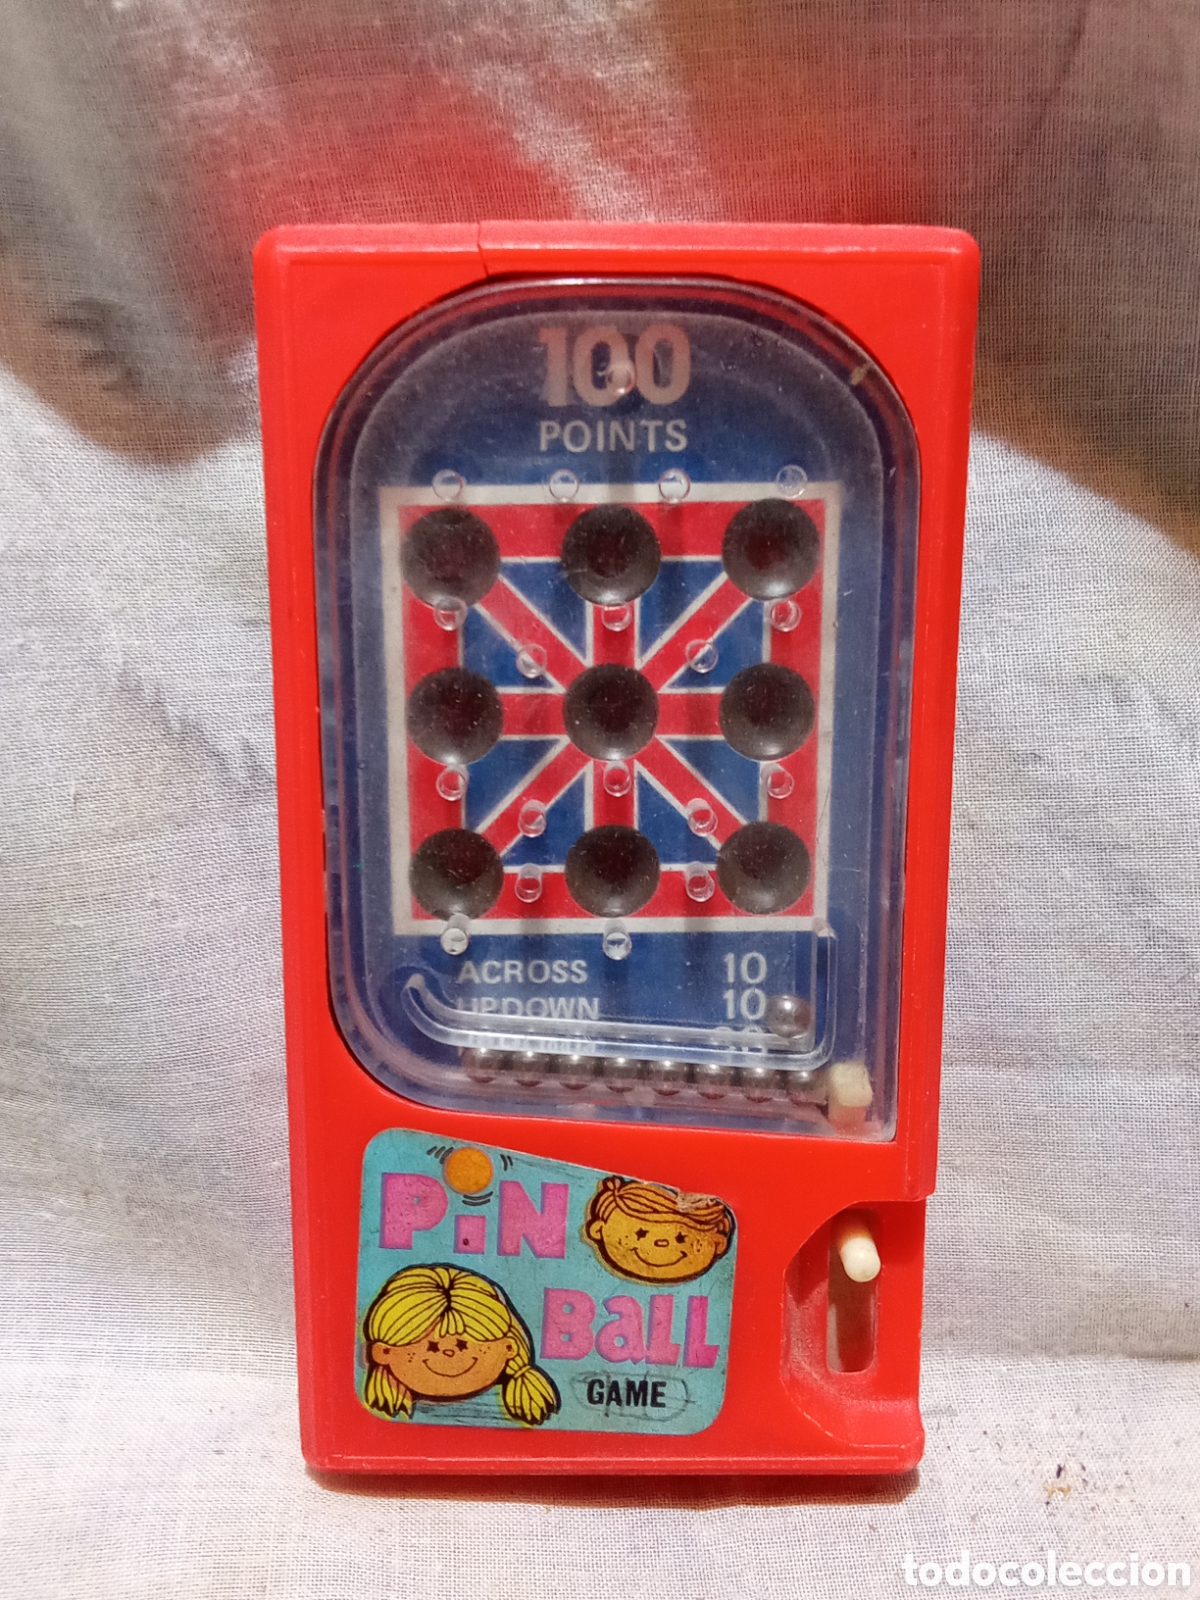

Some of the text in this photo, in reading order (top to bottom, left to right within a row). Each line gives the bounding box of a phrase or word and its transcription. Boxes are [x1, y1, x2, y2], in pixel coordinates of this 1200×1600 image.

[538, 324, 691, 407] 100
[539, 420, 688, 452] POINTS
[457, 951, 767, 984] ACROSS 10
[723, 988, 767, 1021] 10
[587, 1378, 667, 1409] GAME
